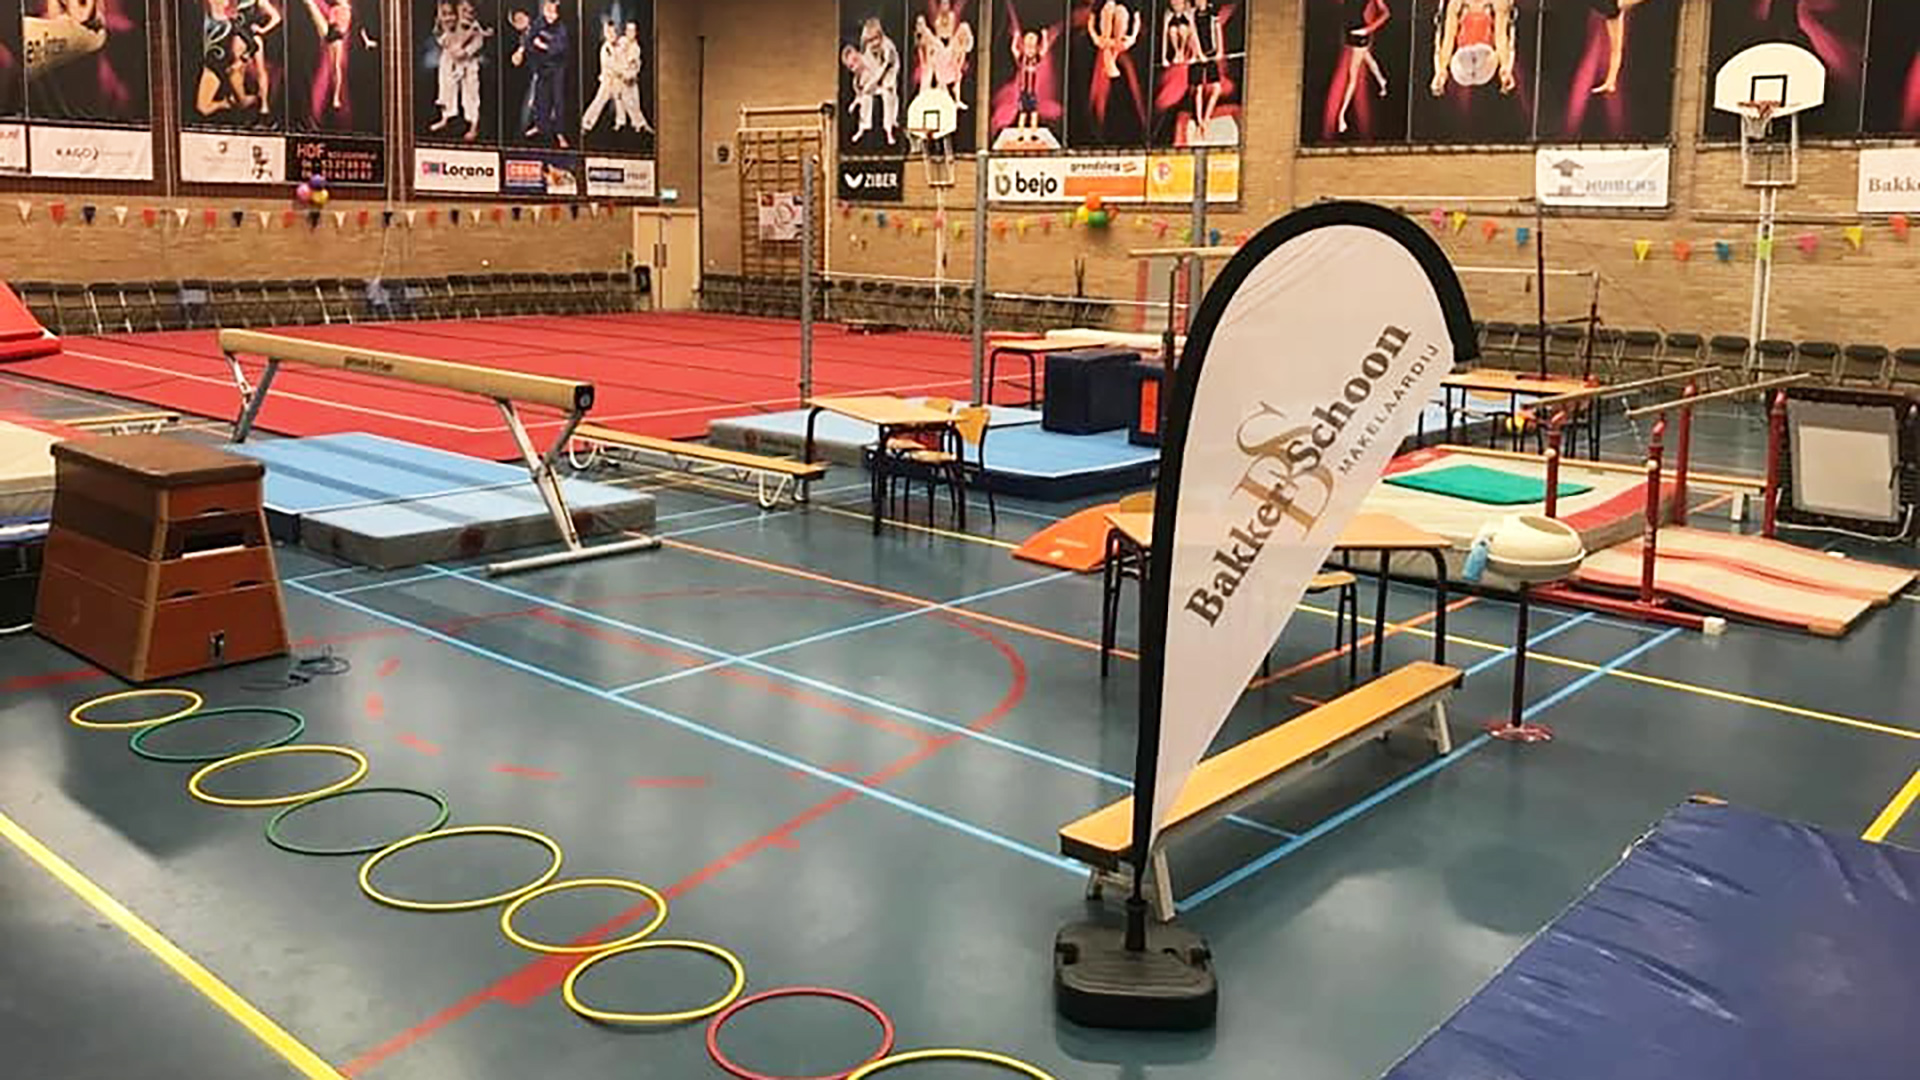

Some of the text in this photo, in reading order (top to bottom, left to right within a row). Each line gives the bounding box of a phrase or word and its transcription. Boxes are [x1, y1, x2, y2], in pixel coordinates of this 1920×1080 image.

[296, 143, 325, 159] HOF
[864, 172, 898, 188] ZIBER
[1015, 170, 1059, 197] bejo
[1868, 177, 1920, 193] Bakk
[1338, 343, 1440, 476] MAKELAARDIJ
[1184, 323, 1412, 628] Bakker Schoon
